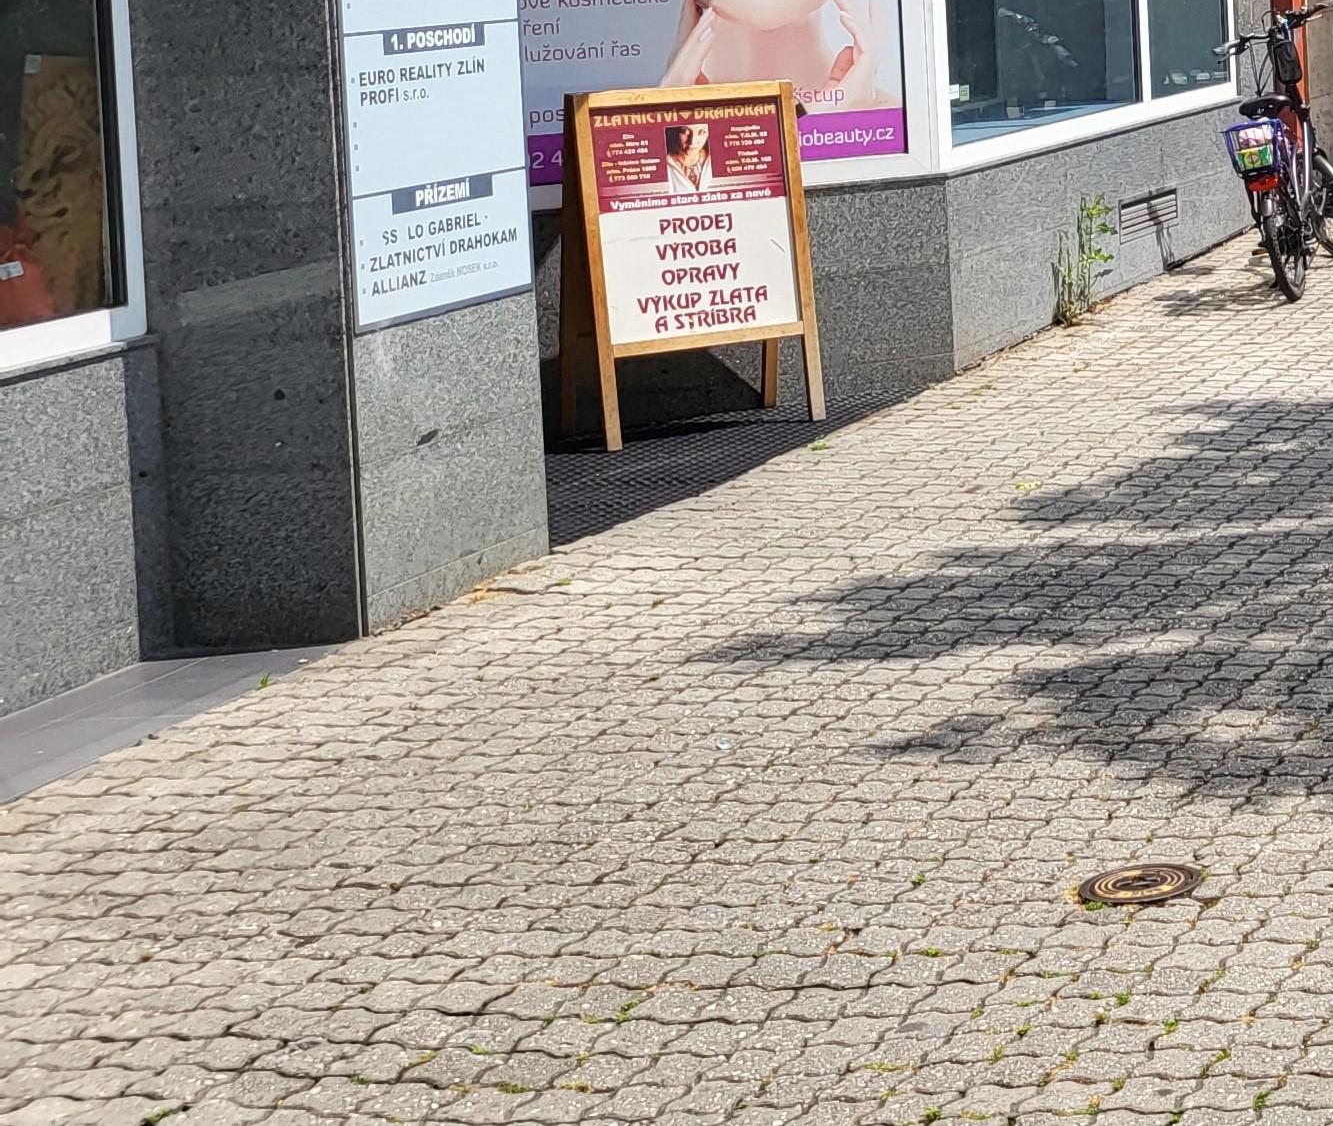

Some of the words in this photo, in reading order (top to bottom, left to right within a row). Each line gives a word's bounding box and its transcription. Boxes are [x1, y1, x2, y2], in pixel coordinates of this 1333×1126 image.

[390, 33, 404, 51] 1.
[407, 24, 476, 50] POSCHODÍ
[523, 18, 561, 36] ření
[525, 37, 605, 63] lužování
[611, 39, 641, 58] řas
[358, 68, 395, 87] EURO
[400, 62, 453, 83] REALITY
[457, 55, 485, 75] ZLÍN
[360, 88, 400, 107] PROFI
[402, 87, 430, 102] s.r.o.
[593, 108, 679, 128] ZLATNICTVÍ
[694, 102, 776, 120] DRAHOKAM
[415, 177, 471, 207] PŘÍZEMÍ
[609, 197, 668, 211] Vyměníme
[670, 194, 700, 205] staré
[701, 191, 728, 202] zlato
[730, 190, 743, 199] za
[745, 187, 772, 198] nové
[659, 213, 733, 235] PRODEJ
[369, 239, 446, 272] ZLATNICTVÍ
[449, 227, 518, 255] DRAHOKAM
[655, 238, 737, 262] VÝROBA
[371, 270, 428, 296] ALLIANZ
[661, 262, 740, 286] OPRAVY
[637, 291, 701, 315] VÝKUP
[709, 285, 768, 307] ZLATA
[654, 316, 668, 333] A
